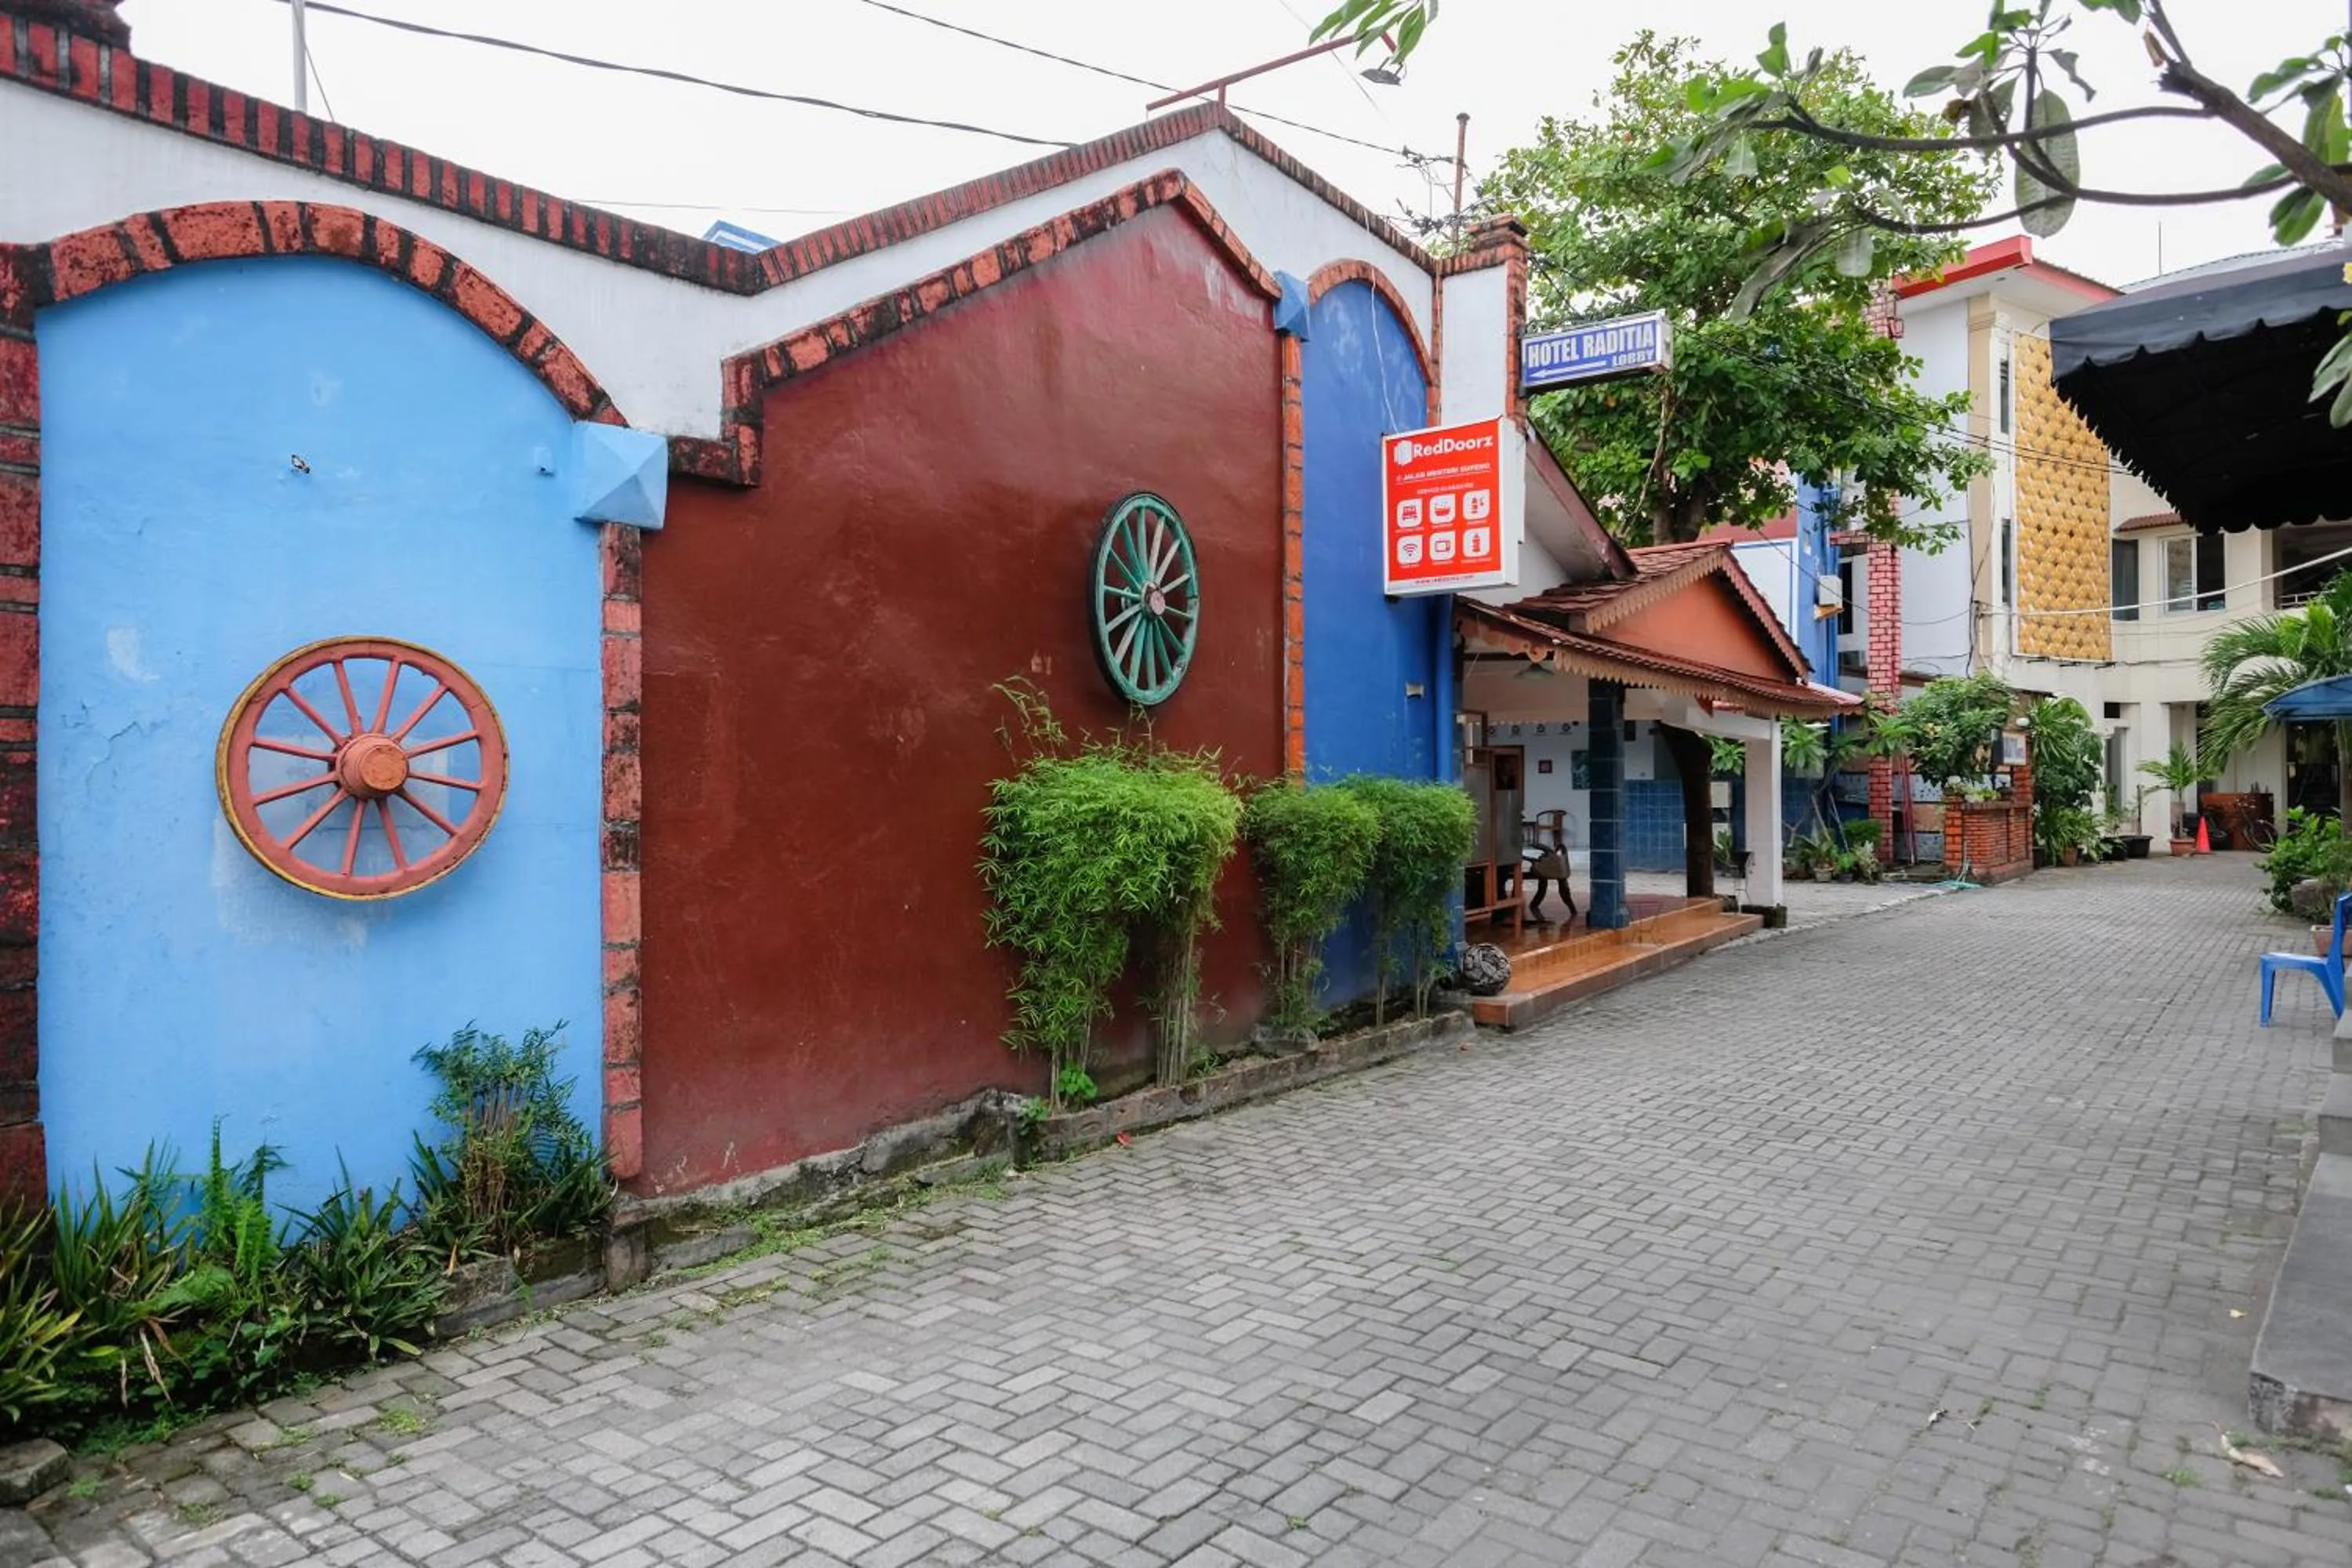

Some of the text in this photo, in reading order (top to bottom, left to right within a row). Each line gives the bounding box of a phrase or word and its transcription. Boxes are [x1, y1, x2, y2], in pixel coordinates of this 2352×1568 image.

[1528, 323, 1654, 367] HOTEL RADITIA
[1612, 349, 1654, 366] LOBBY
[1414, 435, 1493, 458] RedDoorz
[1404, 471, 1425, 481] JALAN
[1427, 466, 1458, 477] MENTERI
